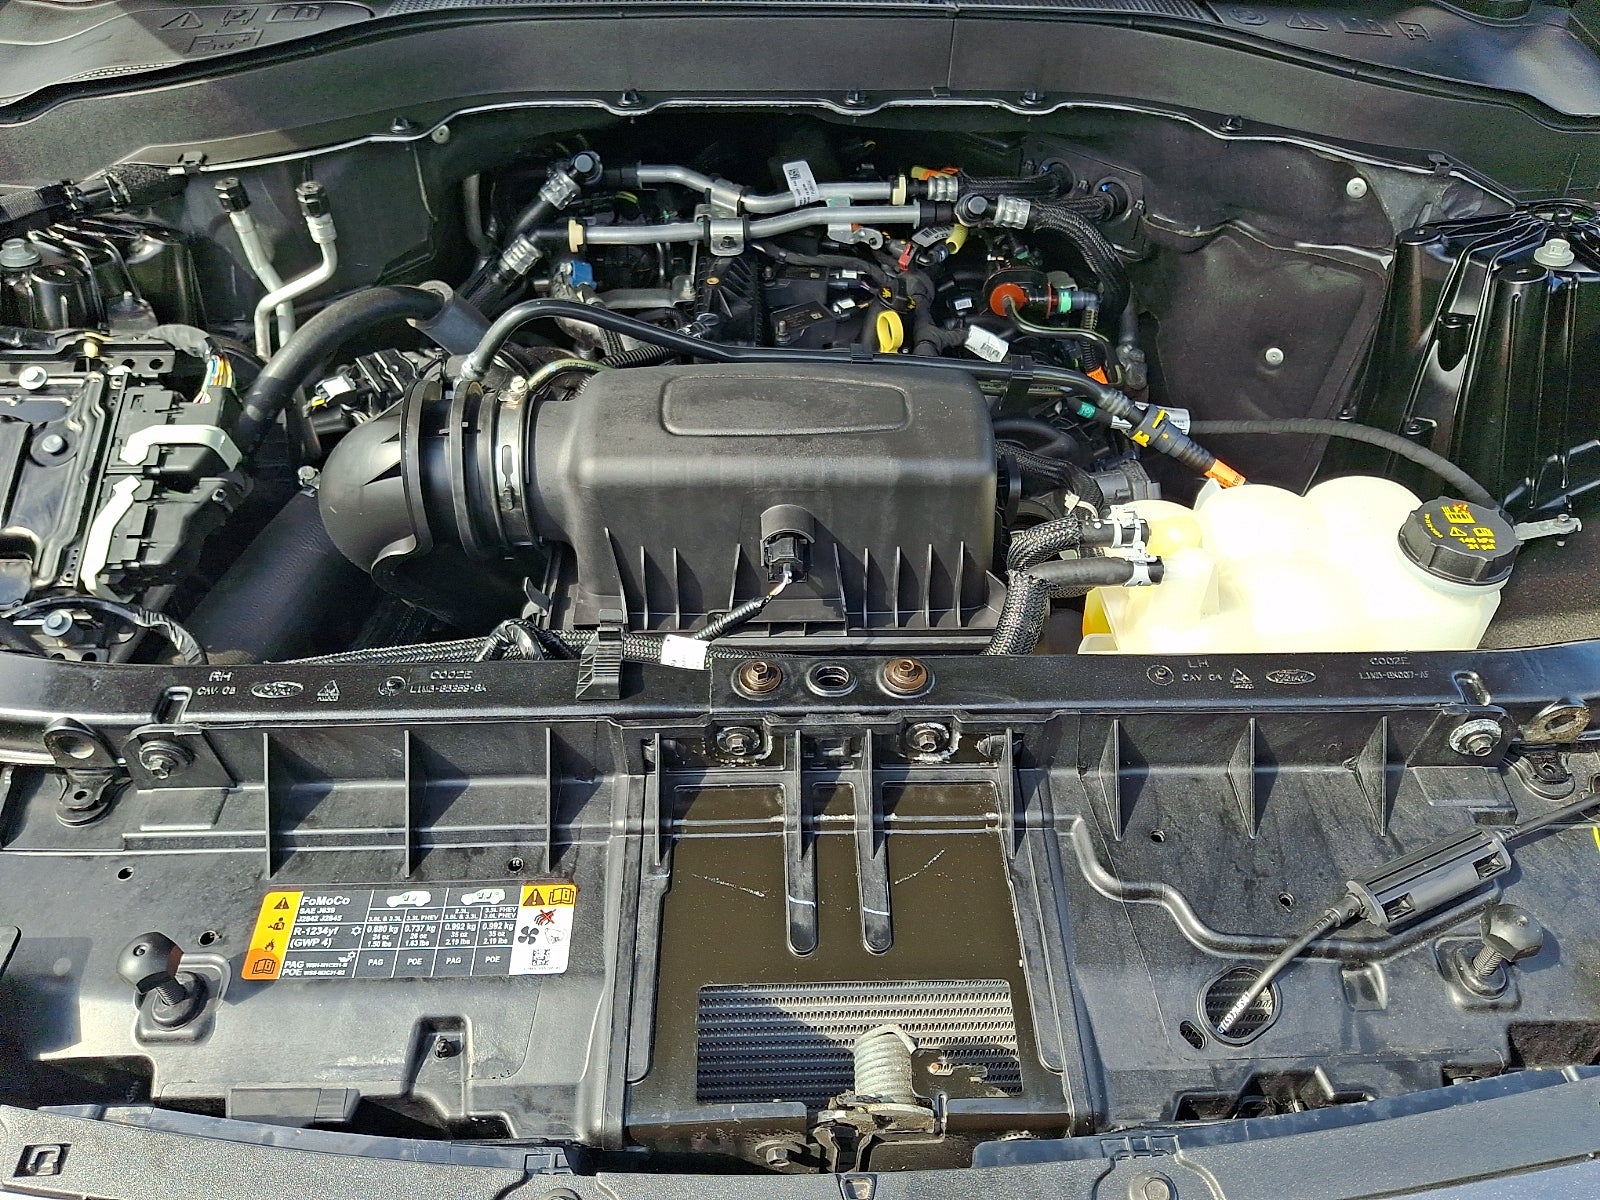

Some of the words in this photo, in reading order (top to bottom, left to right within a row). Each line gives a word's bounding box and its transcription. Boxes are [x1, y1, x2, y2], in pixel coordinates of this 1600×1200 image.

[208, 671, 233, 682] RH
[301, 896, 351, 906] FoMoCo
[299, 907, 317, 915] SAE
[388, 925, 399, 935] kg
[404, 924, 425, 933] 0.737
[426, 924, 437, 933] kg
[444, 923, 466, 931] 0.992
[466, 923, 477, 932] kg
[482, 922, 503, 930] 0.992
[503, 922, 515, 931] kg
[293, 926, 340, 937] R-1234yf
[289, 938, 320, 949] (GWP
[321, 938, 332, 949] 4)
[284, 960, 305, 969] PAG
[367, 958, 384, 966] PAG
[406, 957, 423, 966] POE
[445, 957, 462, 965] PAG
[484, 956, 501, 964] POE
[282, 968, 303, 976] POE
